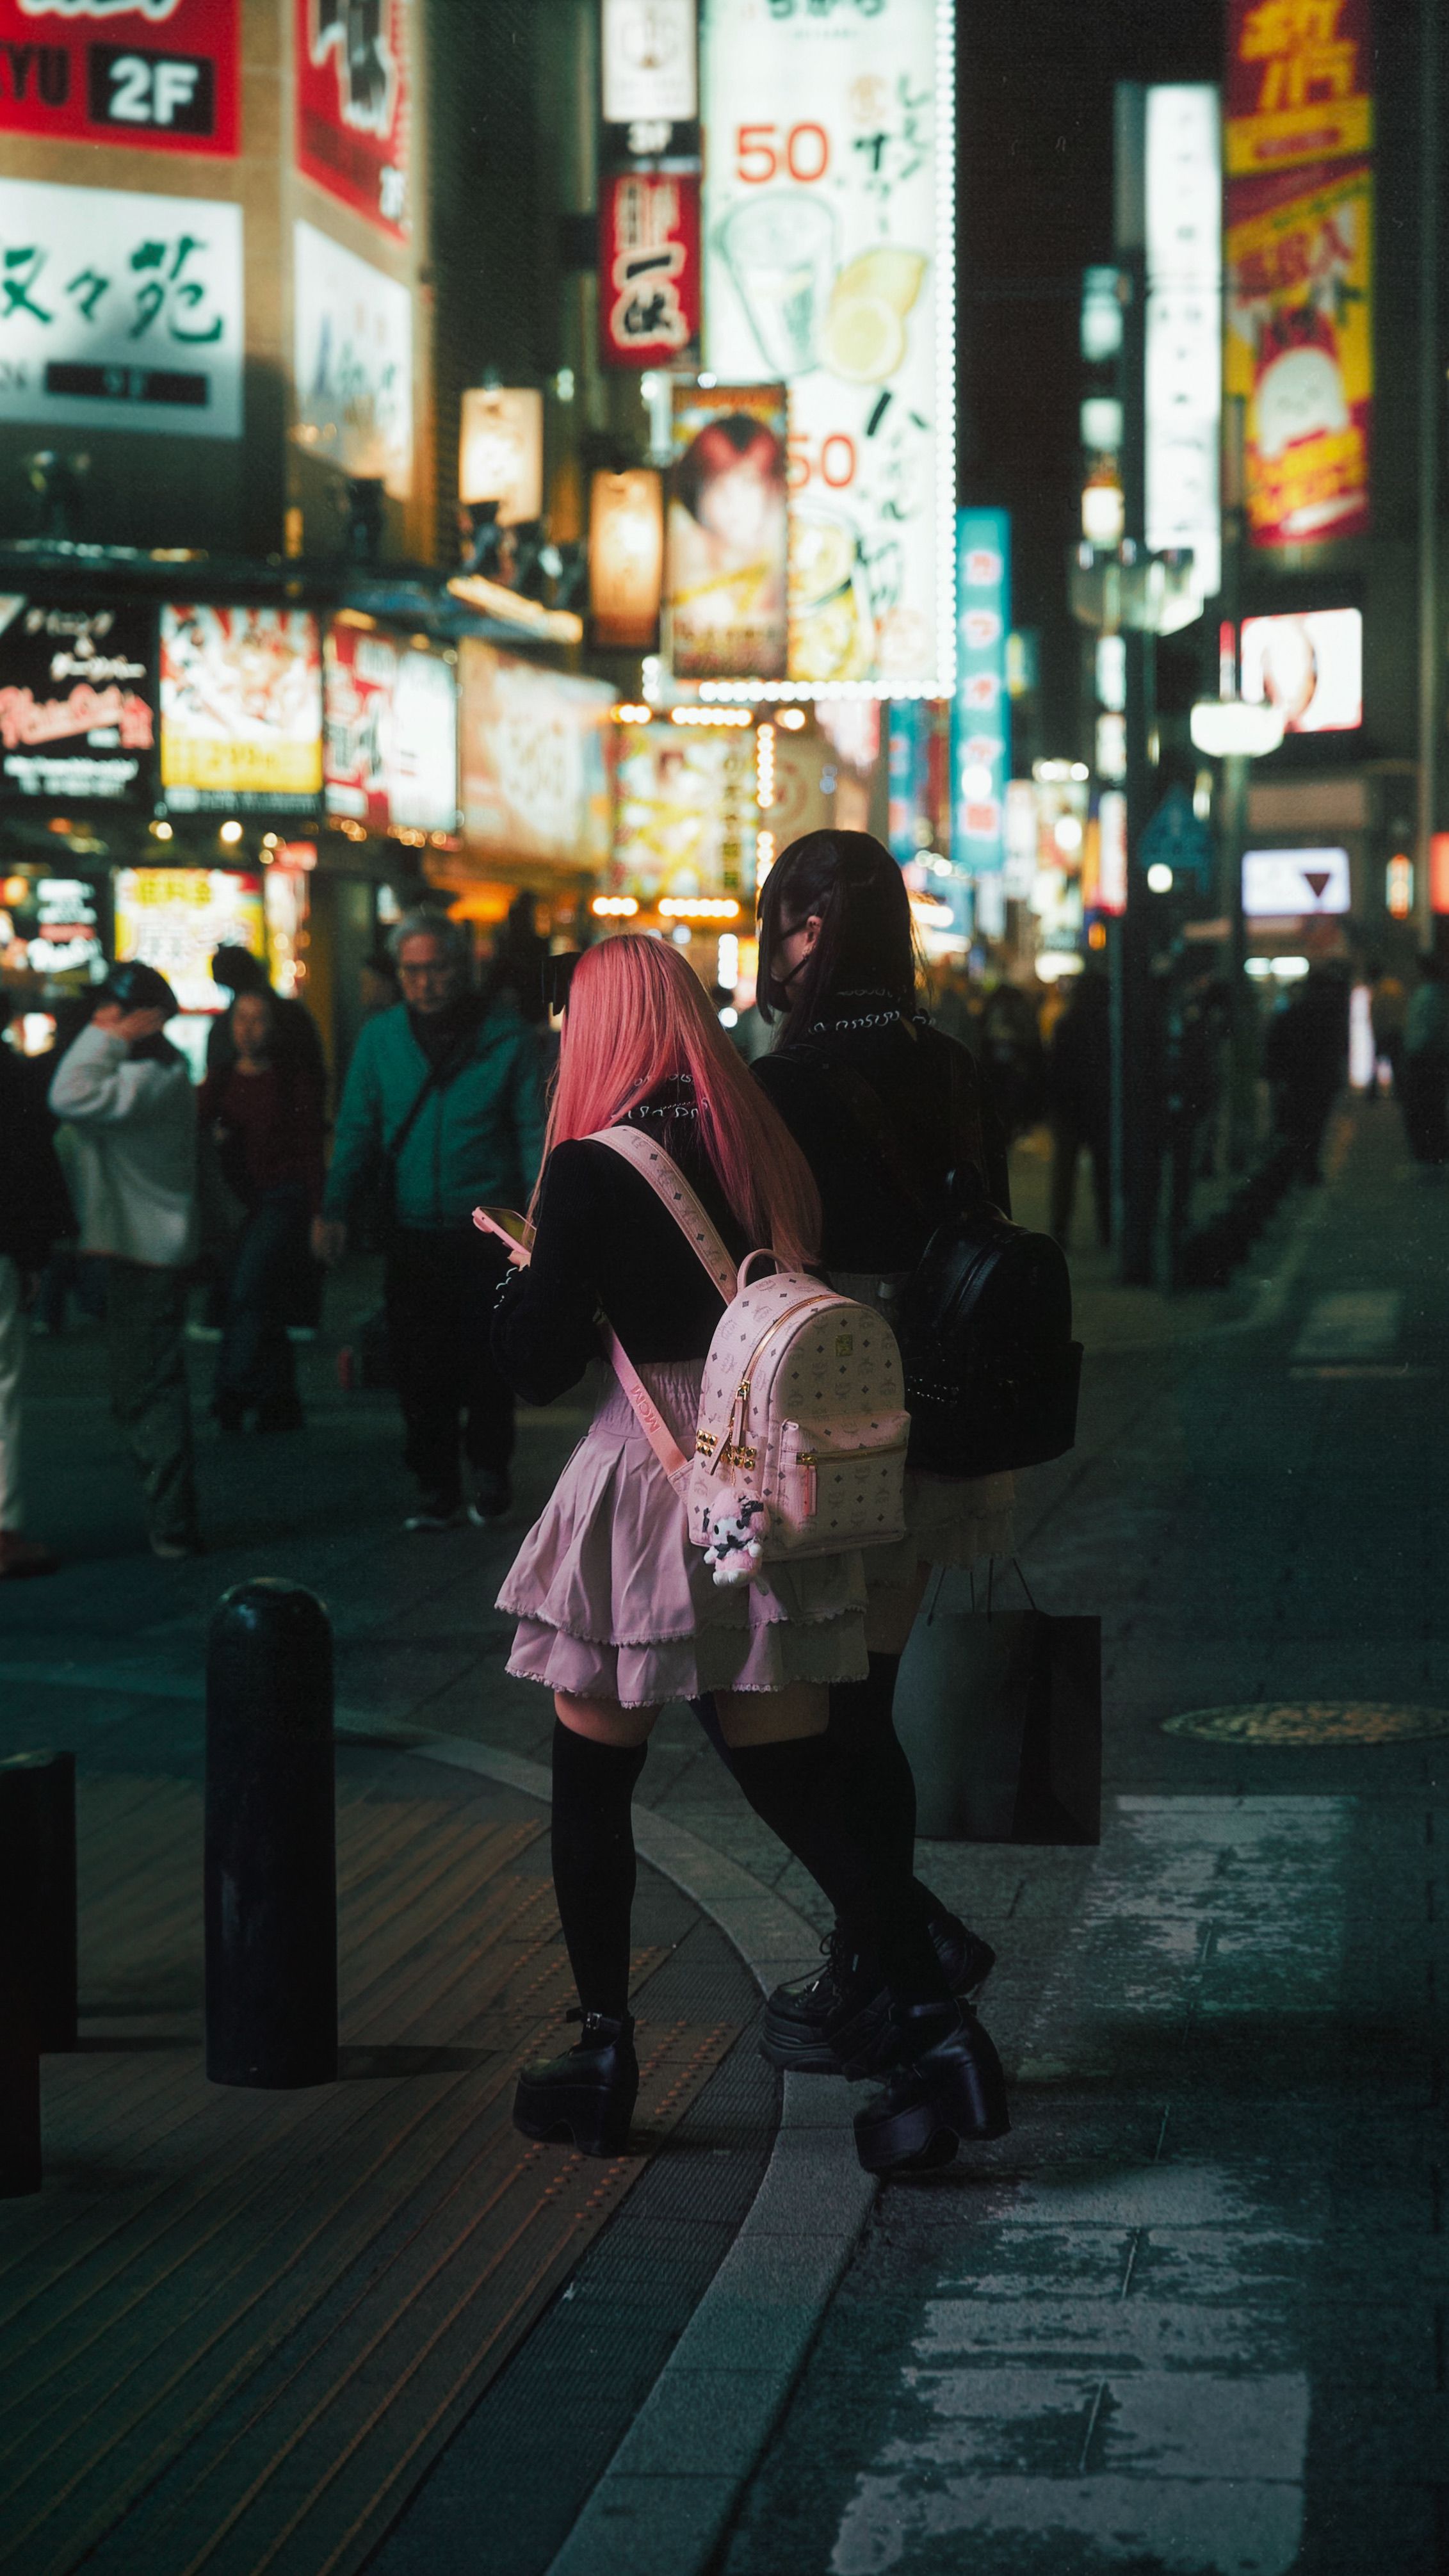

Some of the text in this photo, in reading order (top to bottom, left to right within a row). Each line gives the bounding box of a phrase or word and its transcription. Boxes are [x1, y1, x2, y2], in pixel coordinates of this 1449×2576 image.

[0, 40, 199, 126] YU 2F
[737, 123, 829, 184] 50
[630, 1383, 662, 1434] MCM
